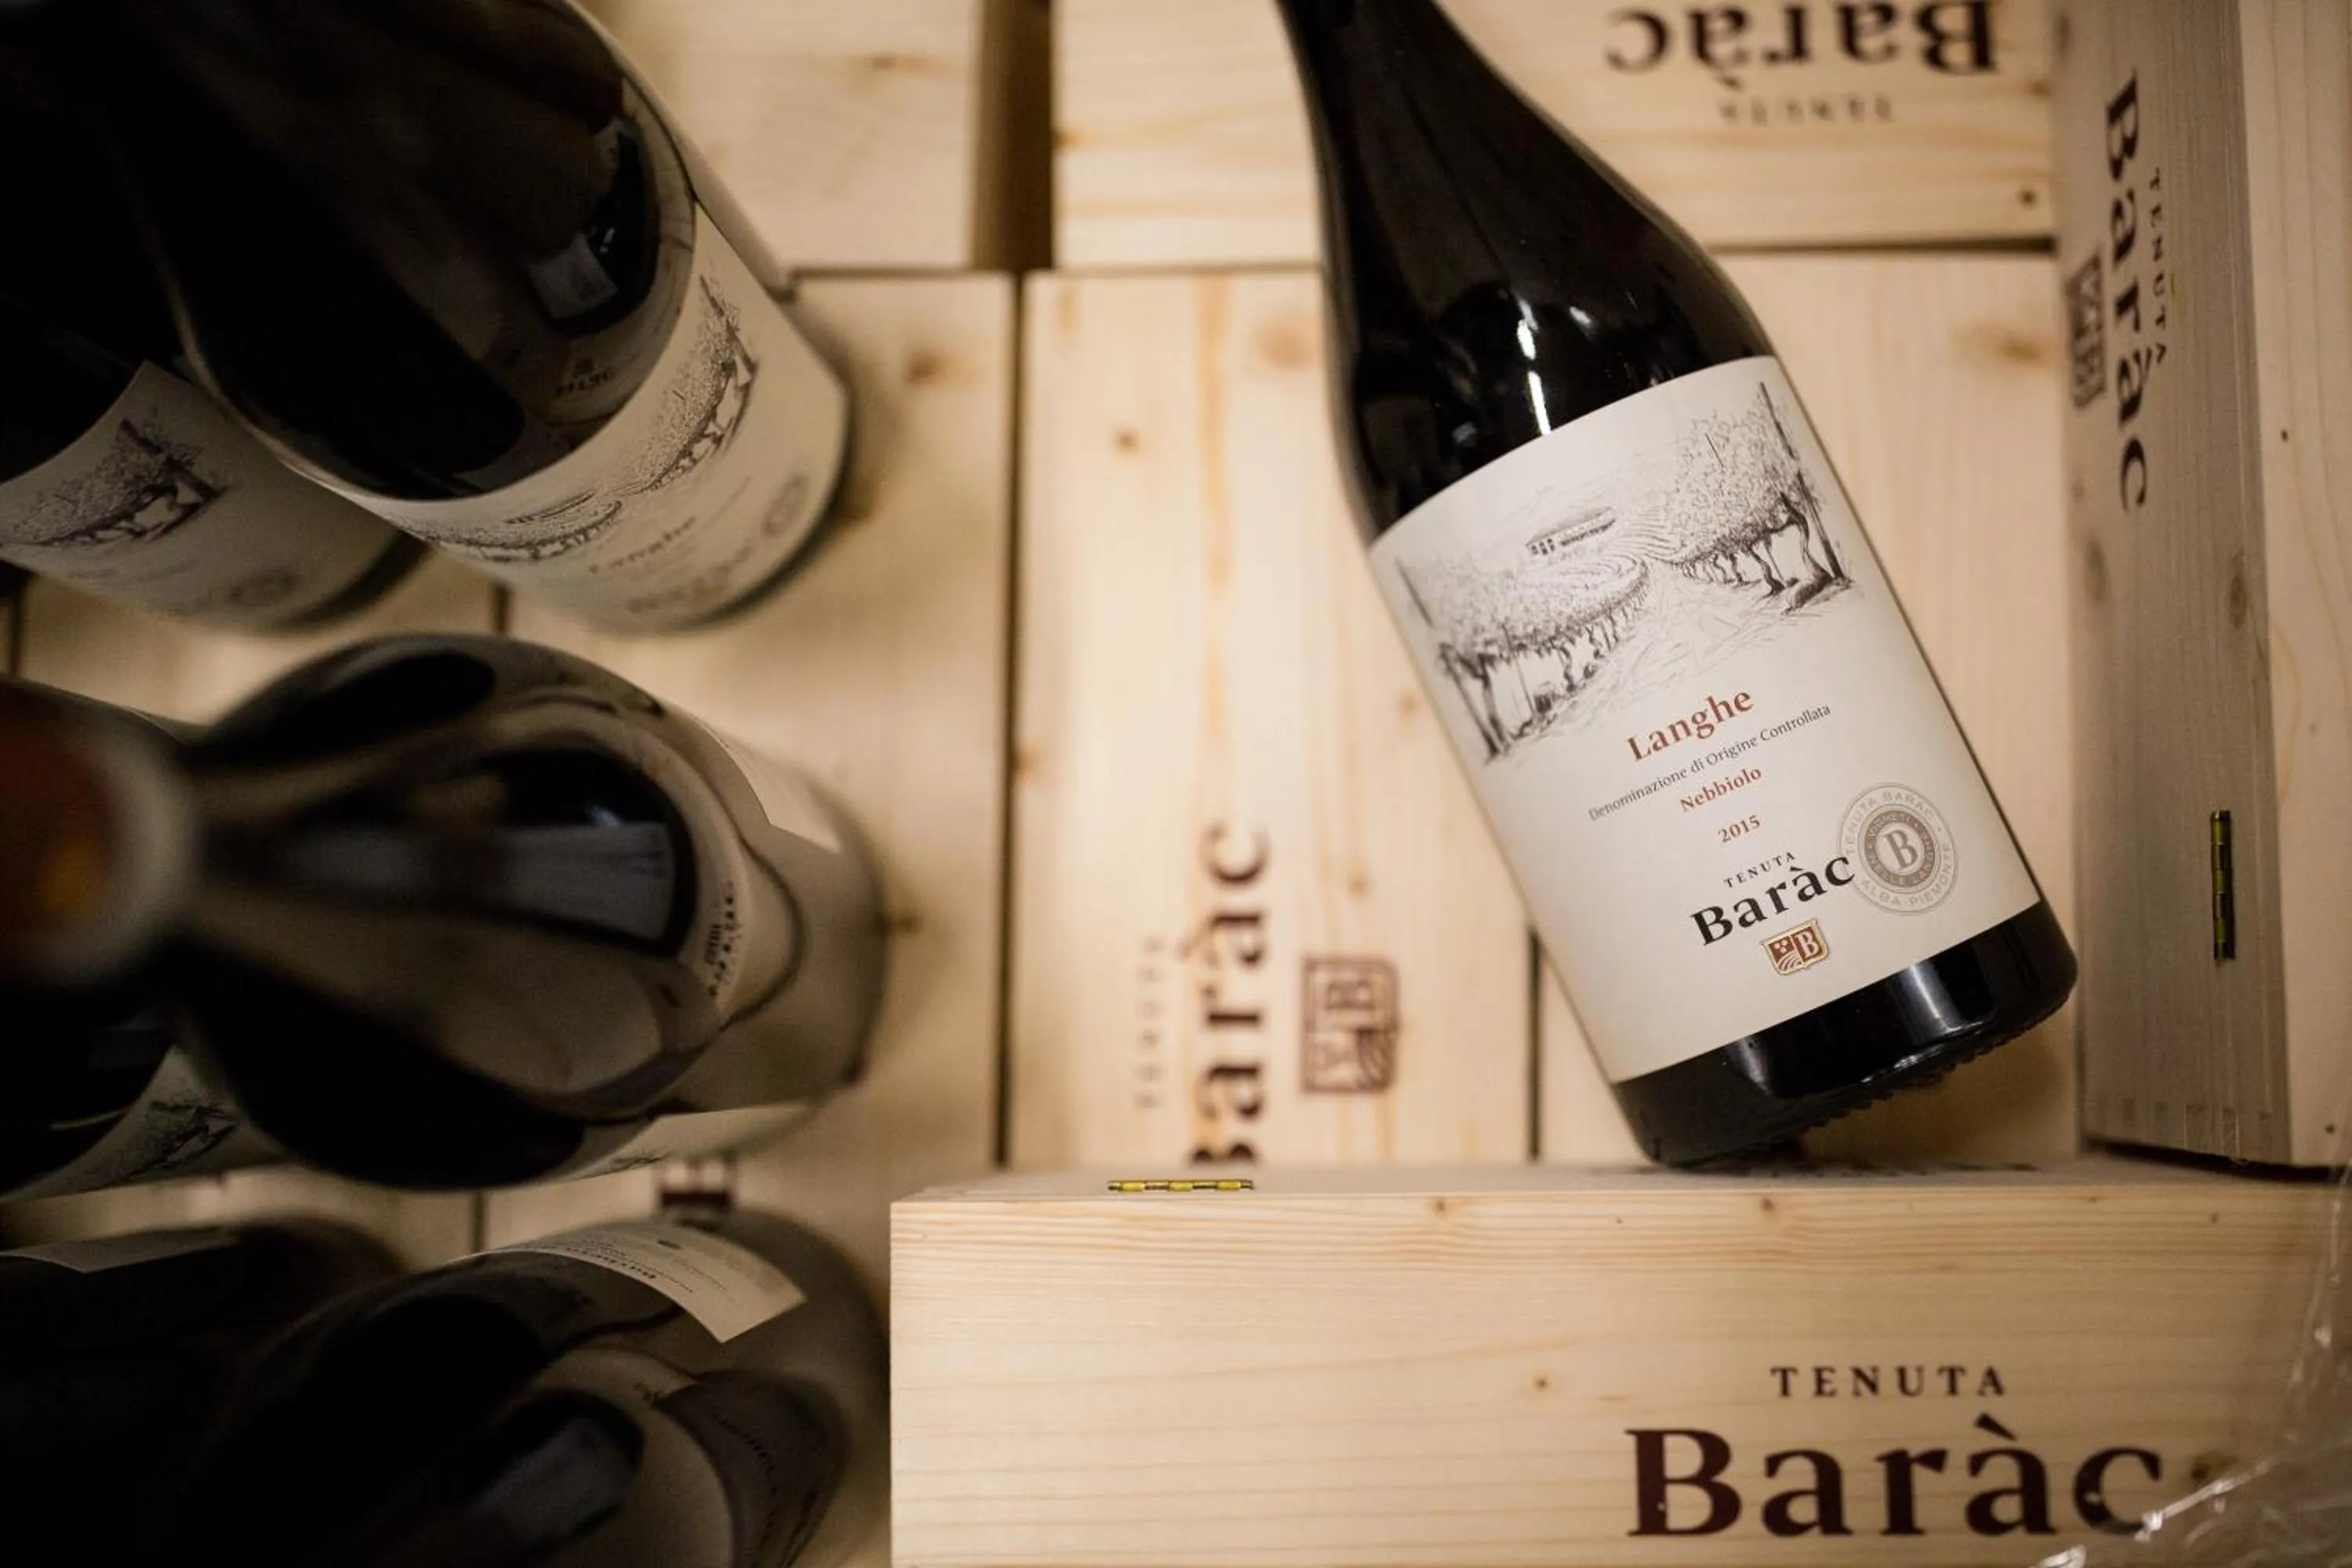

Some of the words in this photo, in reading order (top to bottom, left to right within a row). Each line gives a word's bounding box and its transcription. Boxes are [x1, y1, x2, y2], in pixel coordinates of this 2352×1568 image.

[2104, 69, 2151, 514] Baràc
[1626, 691, 1755, 761] Langhe
[1588, 767, 1688, 822] Denominazione
[1690, 758, 1706, 773] di
[1706, 737, 1759, 766] Origine
[1759, 705, 1831, 742] Controllata
[1679, 768, 1762, 811] Nebbiolo
[1718, 815, 1761, 844] 2015
[1883, 829, 1918, 867] B
[1723, 851, 1797, 889] TENUTA
[1690, 856, 1856, 946] Baràc
[1796, 929, 1821, 959] B
[1770, 1366, 2006, 1397] TENUTA
[1626, 1414, 2162, 1537] Baràc
